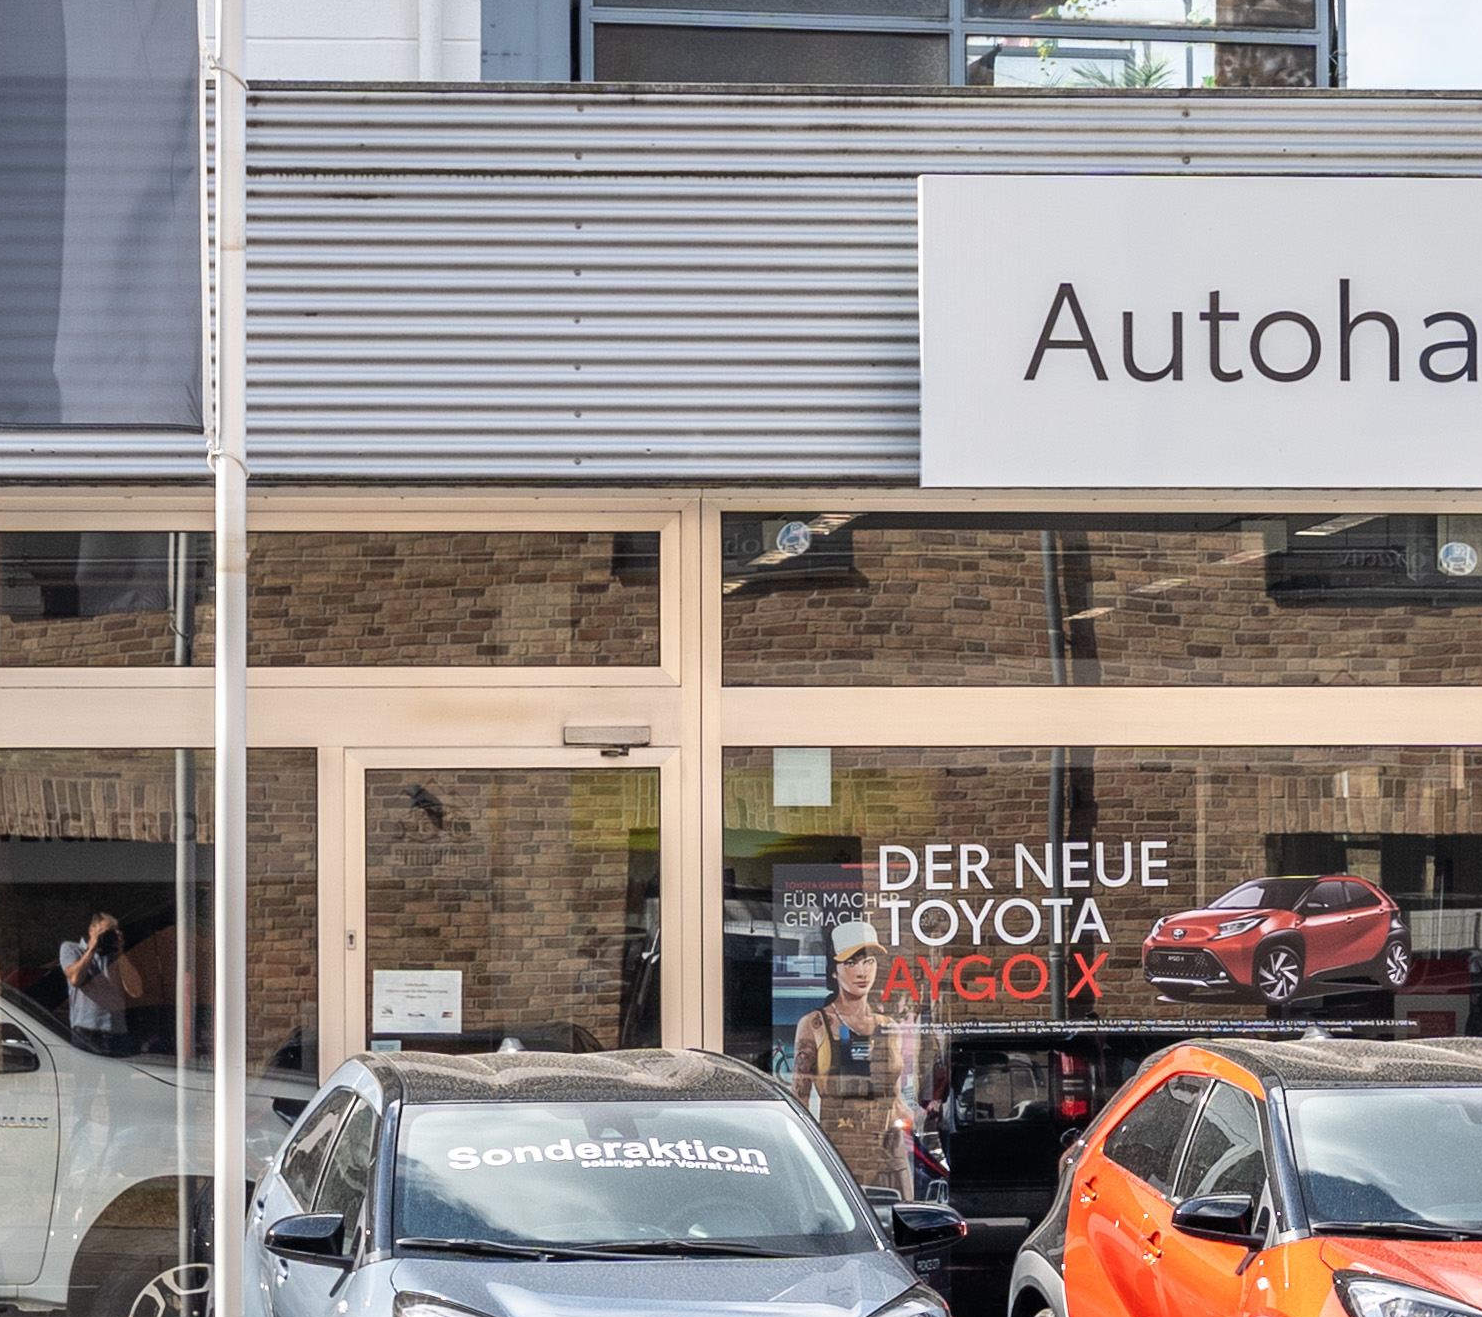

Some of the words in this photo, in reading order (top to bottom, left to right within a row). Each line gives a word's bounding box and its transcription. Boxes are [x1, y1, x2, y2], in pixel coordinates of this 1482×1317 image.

[880, 843, 991, 891] DER
[1014, 841, 1170, 889] NEUE
[783, 890, 818, 908] FÜR
[783, 911, 875, 927] GEMACHT
[880, 896, 1111, 947] TOYOTA
[881, 953, 1050, 1003] AYGO
[1068, 952, 1110, 1000] X
[446, 1136, 768, 1170] Sonderaktion
[581, 1158, 644, 1170] solange
[646, 1157, 674, 1169] der
[676, 1158, 724, 1171] Vorrat
[726, 1161, 771, 1175] reicht
